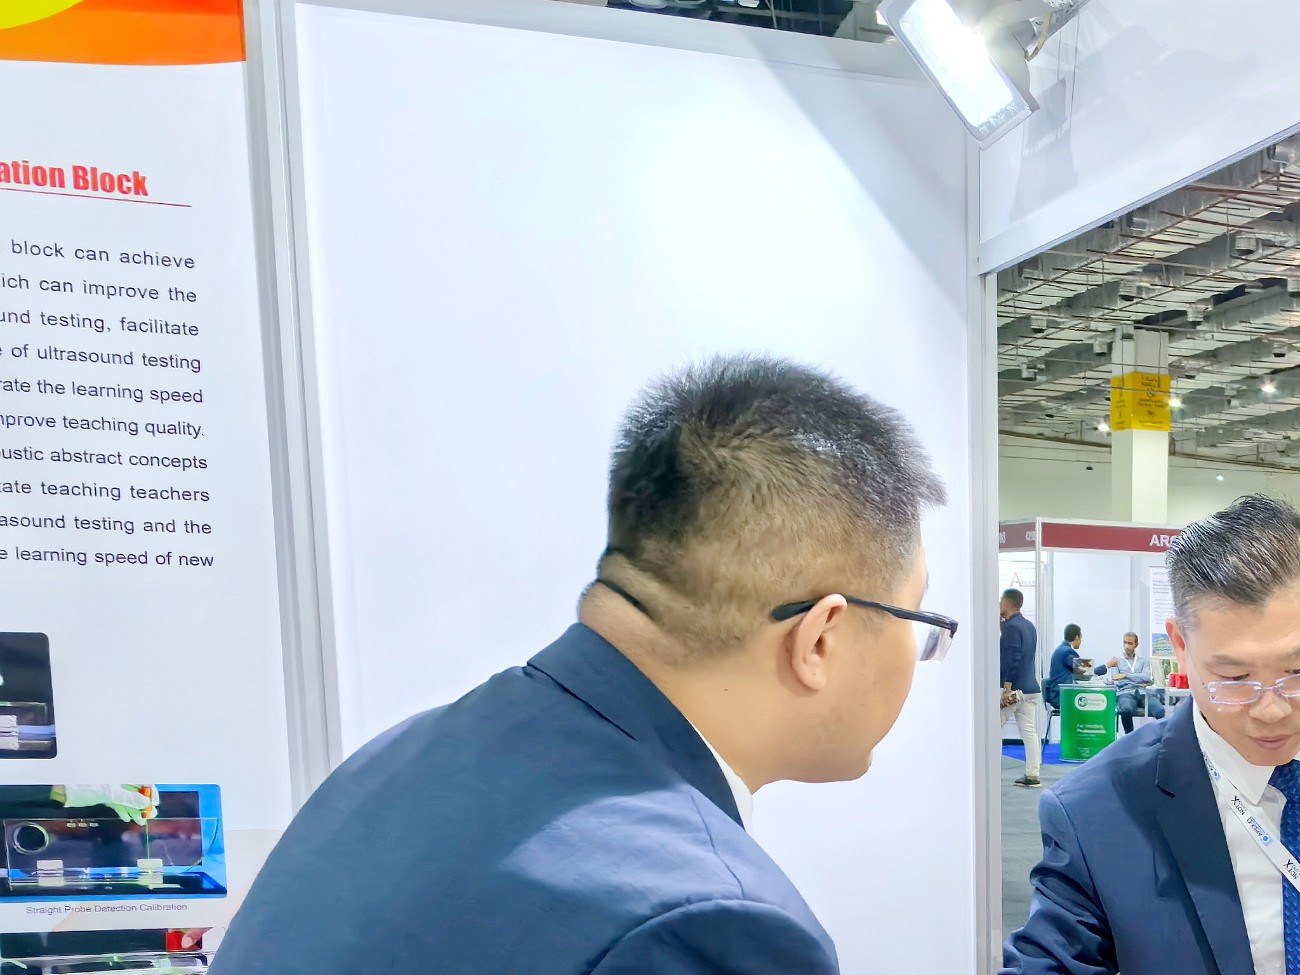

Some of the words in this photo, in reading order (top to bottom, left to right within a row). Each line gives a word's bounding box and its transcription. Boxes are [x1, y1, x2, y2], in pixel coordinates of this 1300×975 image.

[72, 165, 149, 196] Block
[11, 239, 65, 258] block
[74, 248, 110, 262] can
[119, 251, 195, 269] achieve
[39, 279, 73, 293] can
[83, 279, 159, 300] improve
[168, 287, 197, 303] the
[40, 311, 111, 332] testing,
[120, 316, 199, 337] facilitate
[11, 344, 29, 358] of
[37, 347, 134, 366] ultrasound
[142, 352, 201, 373] testing
[0, 379, 31, 393] ate
[37, 379, 65, 395] the
[72, 381, 144, 402] learning
[150, 390, 203, 404] speed
[62, 415, 139, 436] teaching
[145, 421, 205, 440] quality.
[0, 447, 44, 462] ustic
[50, 448, 123, 465] abstract
[129, 453, 208, 472] concepts
[41, 481, 121, 501] teaching
[130, 485, 210, 502] teachers
[74, 516, 135, 535] testing
[143, 519, 176, 533] and
[184, 520, 212, 534] the
[15, 546, 87, 566] learning
[95, 550, 148, 567] speed
[155, 551, 173, 566] of
[179, 554, 214, 567] new
[26, 906, 62, 915] Straight
[64, 905, 92, 913] Probe
[94, 904, 137, 913] Detection
[140, 903, 187, 912] Calibration
